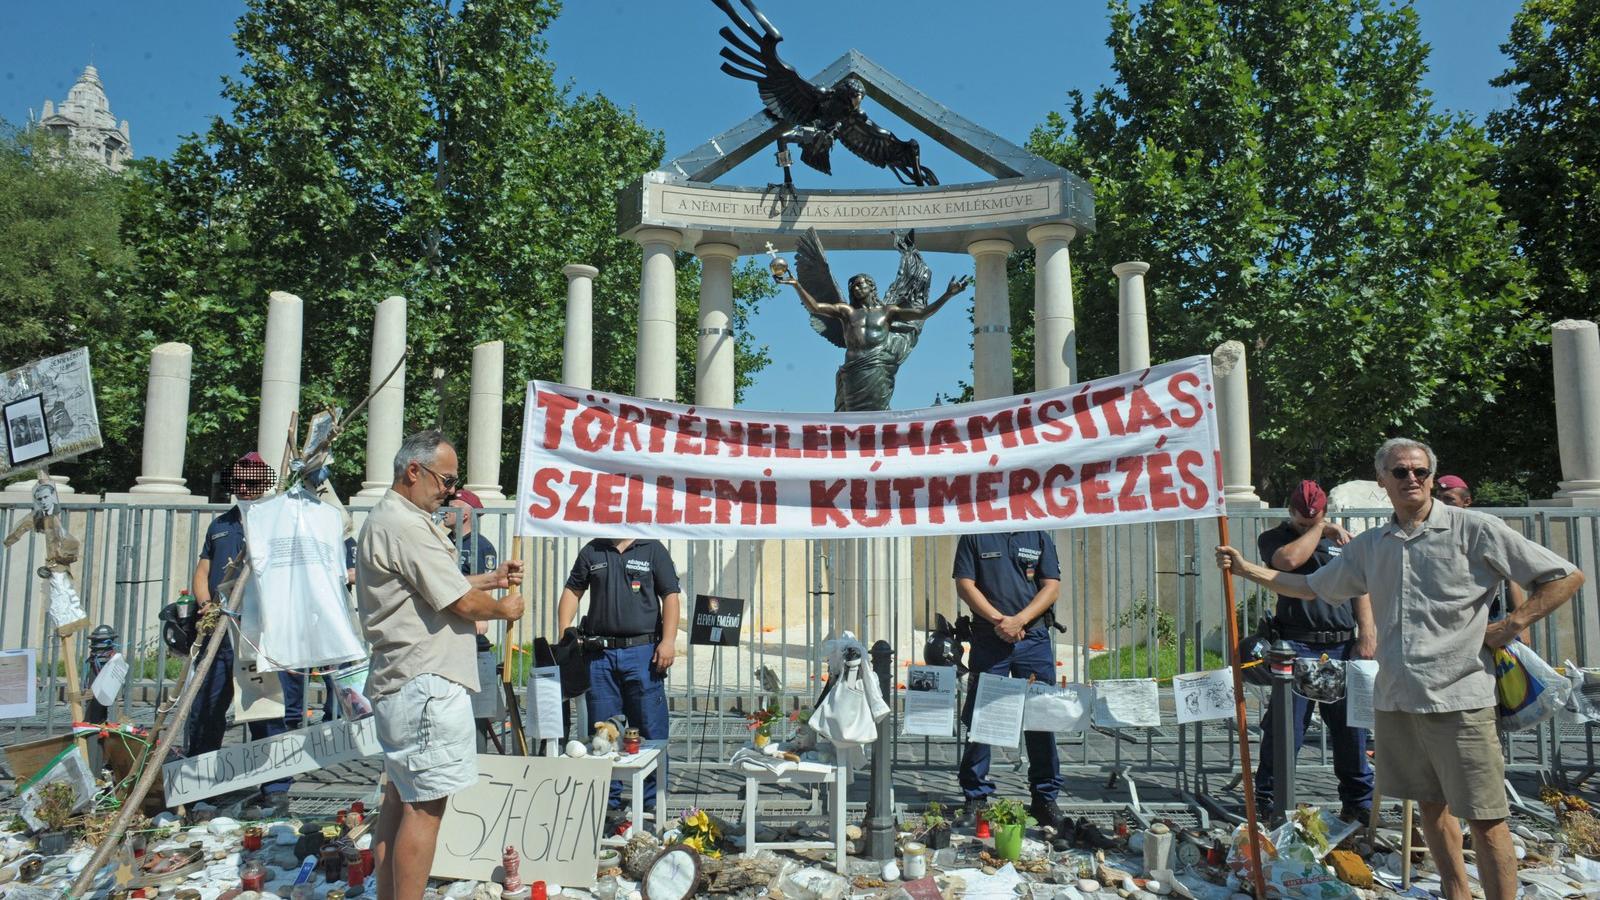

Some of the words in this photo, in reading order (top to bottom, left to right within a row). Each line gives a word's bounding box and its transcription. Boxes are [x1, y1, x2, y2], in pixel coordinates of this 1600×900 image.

[678, 199, 688, 210] A
[691, 200, 738, 213] NÉMET
[529, 468, 777, 525] SZELLEMI
[809, 435, 1224, 528] KÚTMÉRGEZÉS!
[696, 613, 716, 626] ELEVEN
[446, 765, 605, 862] SZÉGYEN
